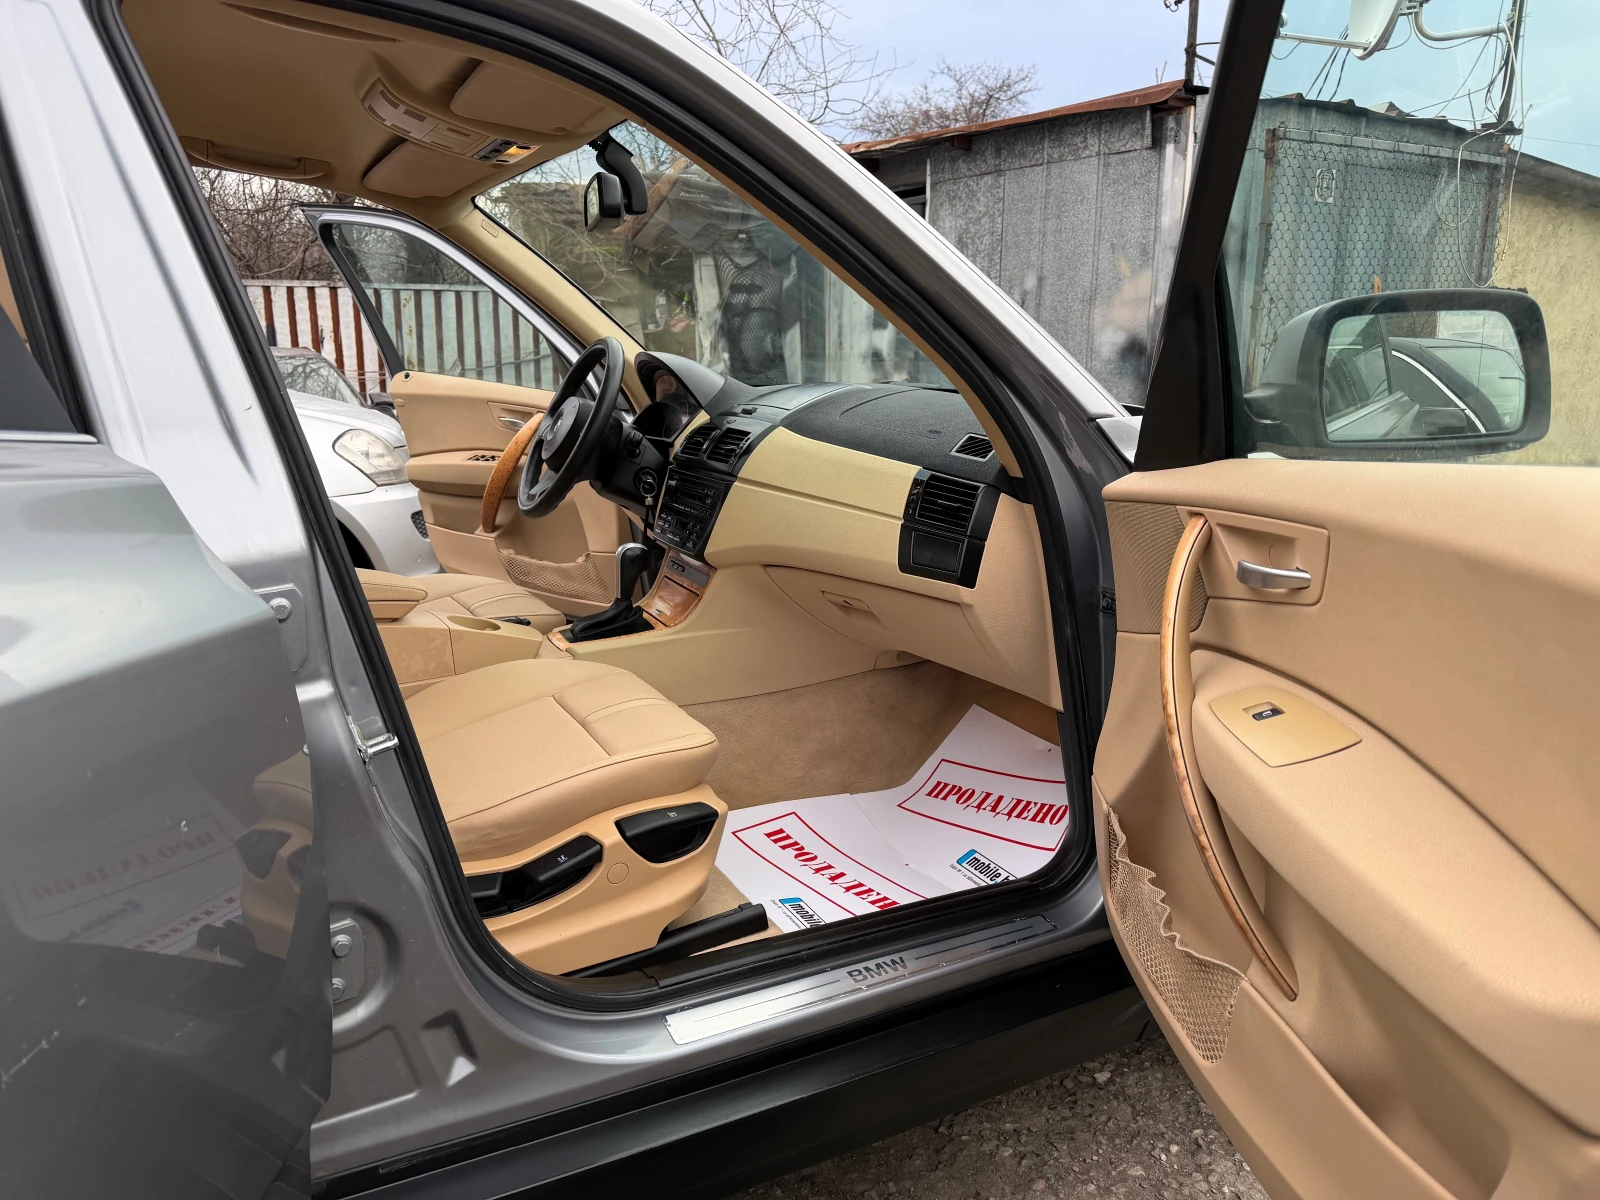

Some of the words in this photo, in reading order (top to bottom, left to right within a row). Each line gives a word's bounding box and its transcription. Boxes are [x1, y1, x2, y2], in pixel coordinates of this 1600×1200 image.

[925, 780, 1069, 826] ПРОДАДЕНО
[763, 828, 901, 911] ПРОДАДЕН
[846, 956, 908, 984] BMW
